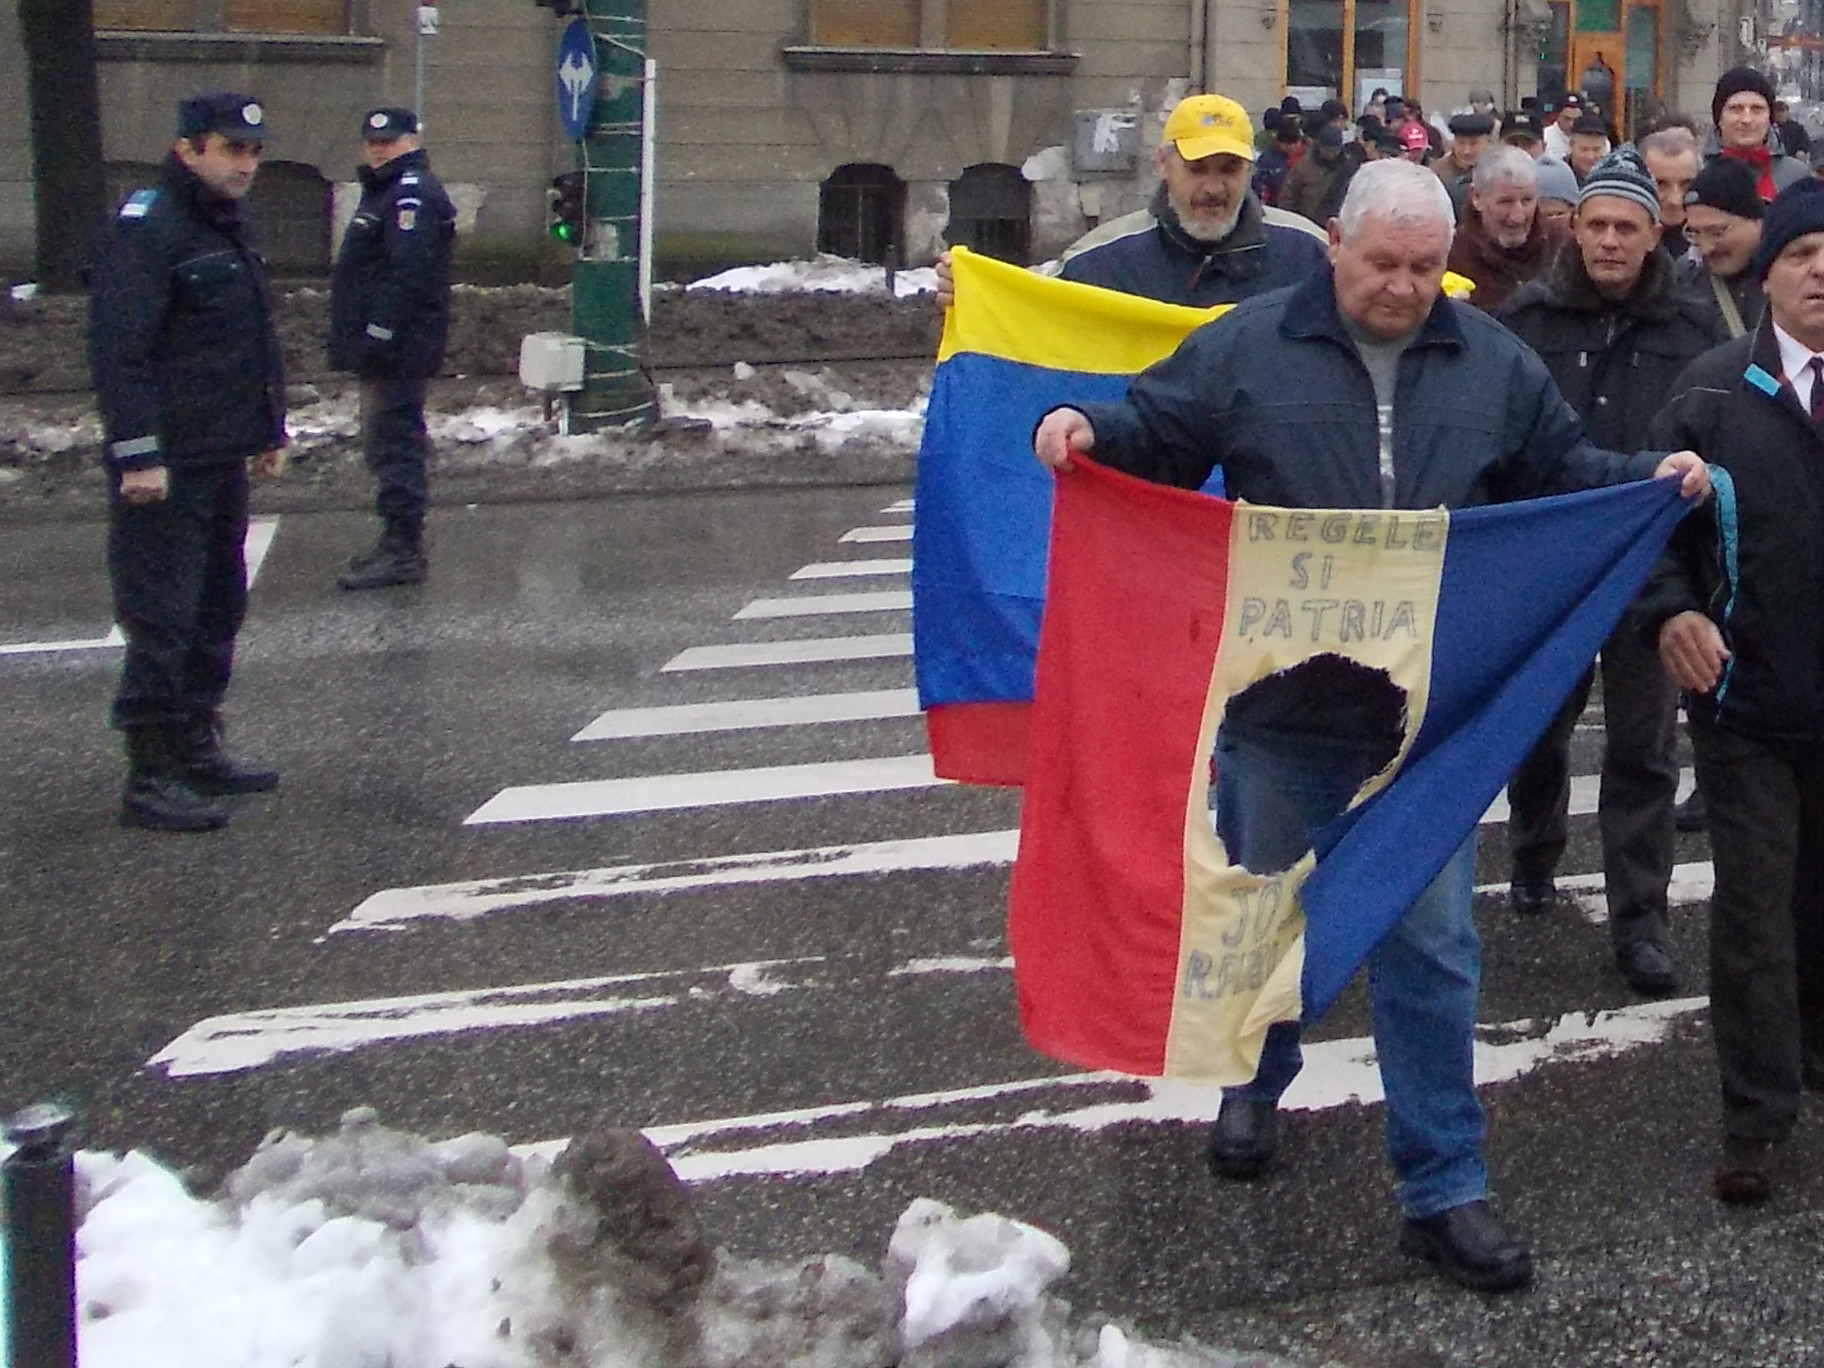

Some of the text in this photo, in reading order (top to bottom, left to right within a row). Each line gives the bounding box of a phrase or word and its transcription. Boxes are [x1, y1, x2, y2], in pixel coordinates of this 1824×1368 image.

[1248, 511, 1445, 551] REGELE
[1289, 551, 1334, 591] SI
[1238, 597, 1417, 644] PATRIA
